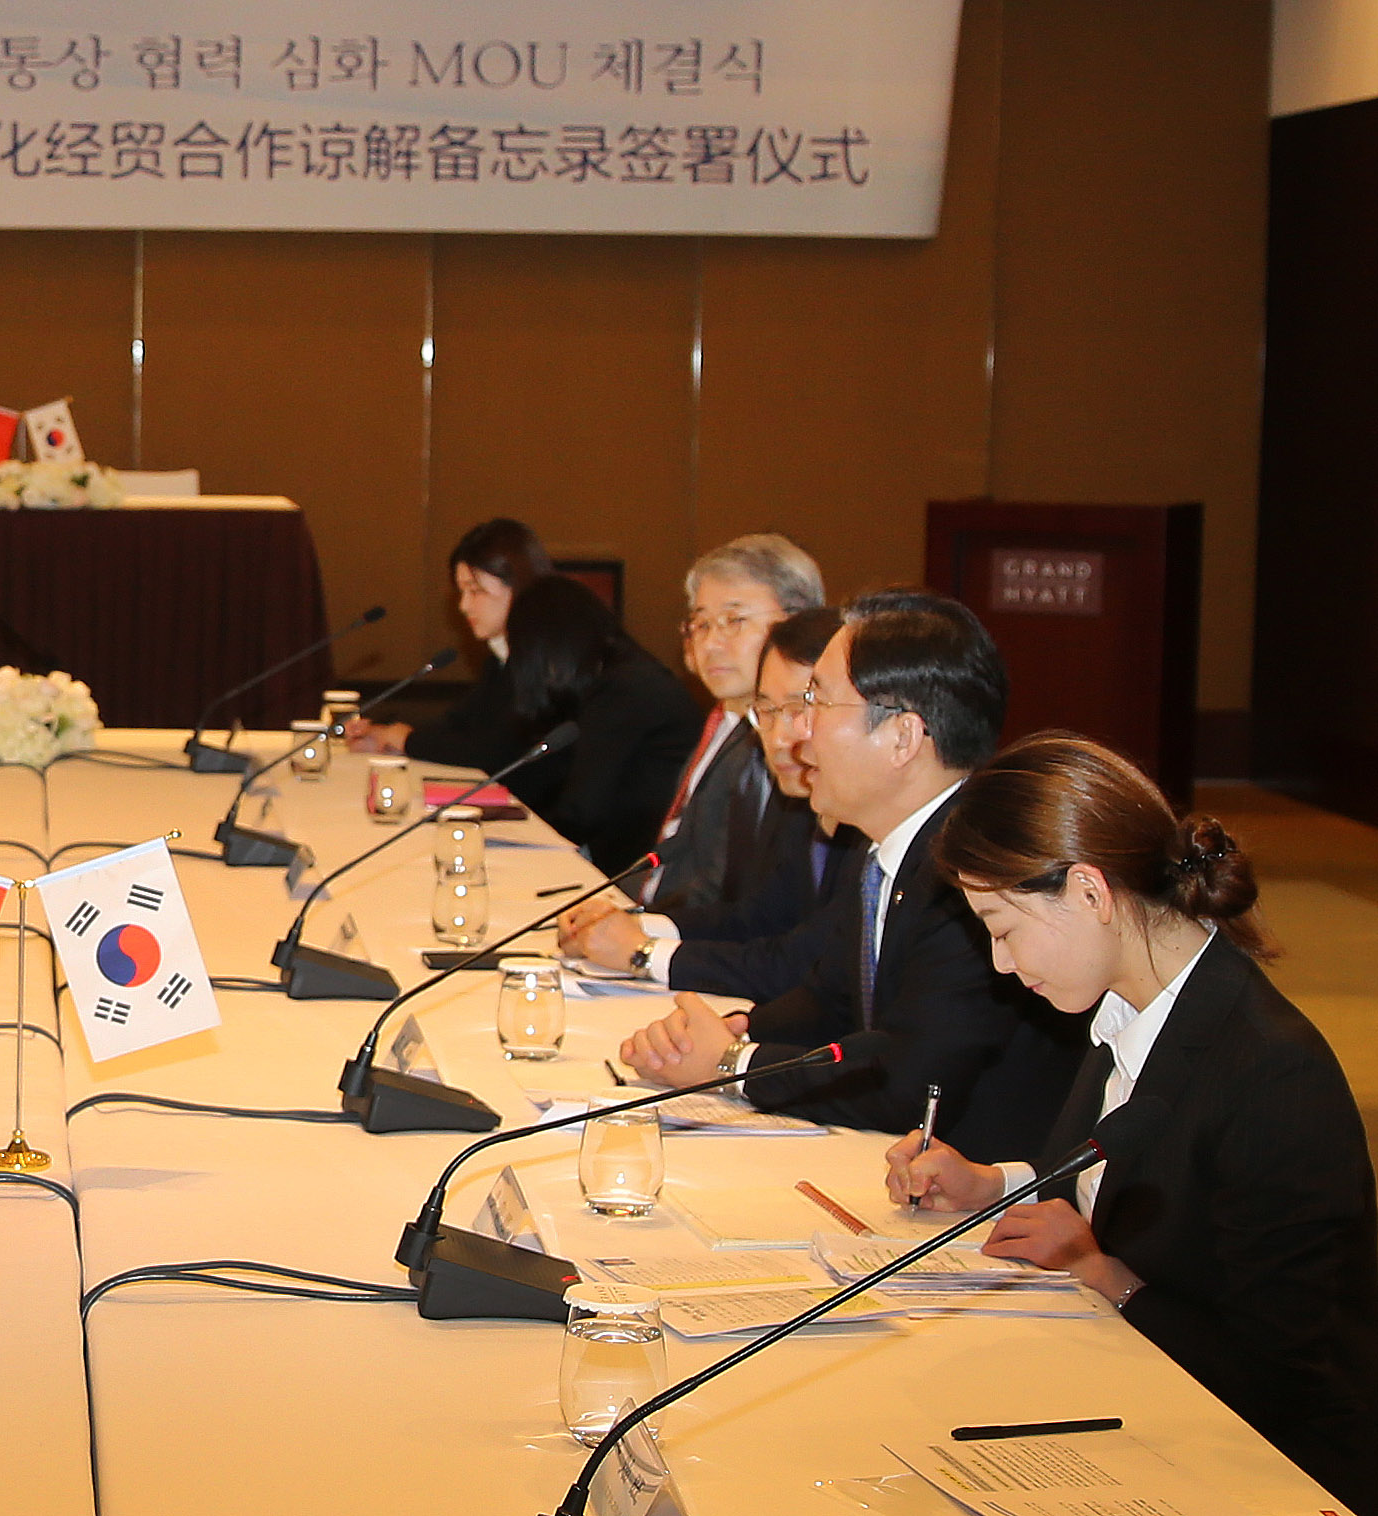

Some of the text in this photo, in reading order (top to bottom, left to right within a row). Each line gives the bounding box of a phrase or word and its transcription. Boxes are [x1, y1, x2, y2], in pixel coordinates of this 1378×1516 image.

[132, 34, 243, 91] 협력
[272, 35, 389, 91] 심화
[408, 38, 569, 90] MOU
[591, 37, 764, 95] 체결식
[1002, 558, 1092, 580] GRAND
[1002, 586, 1087, 604] HYATT
